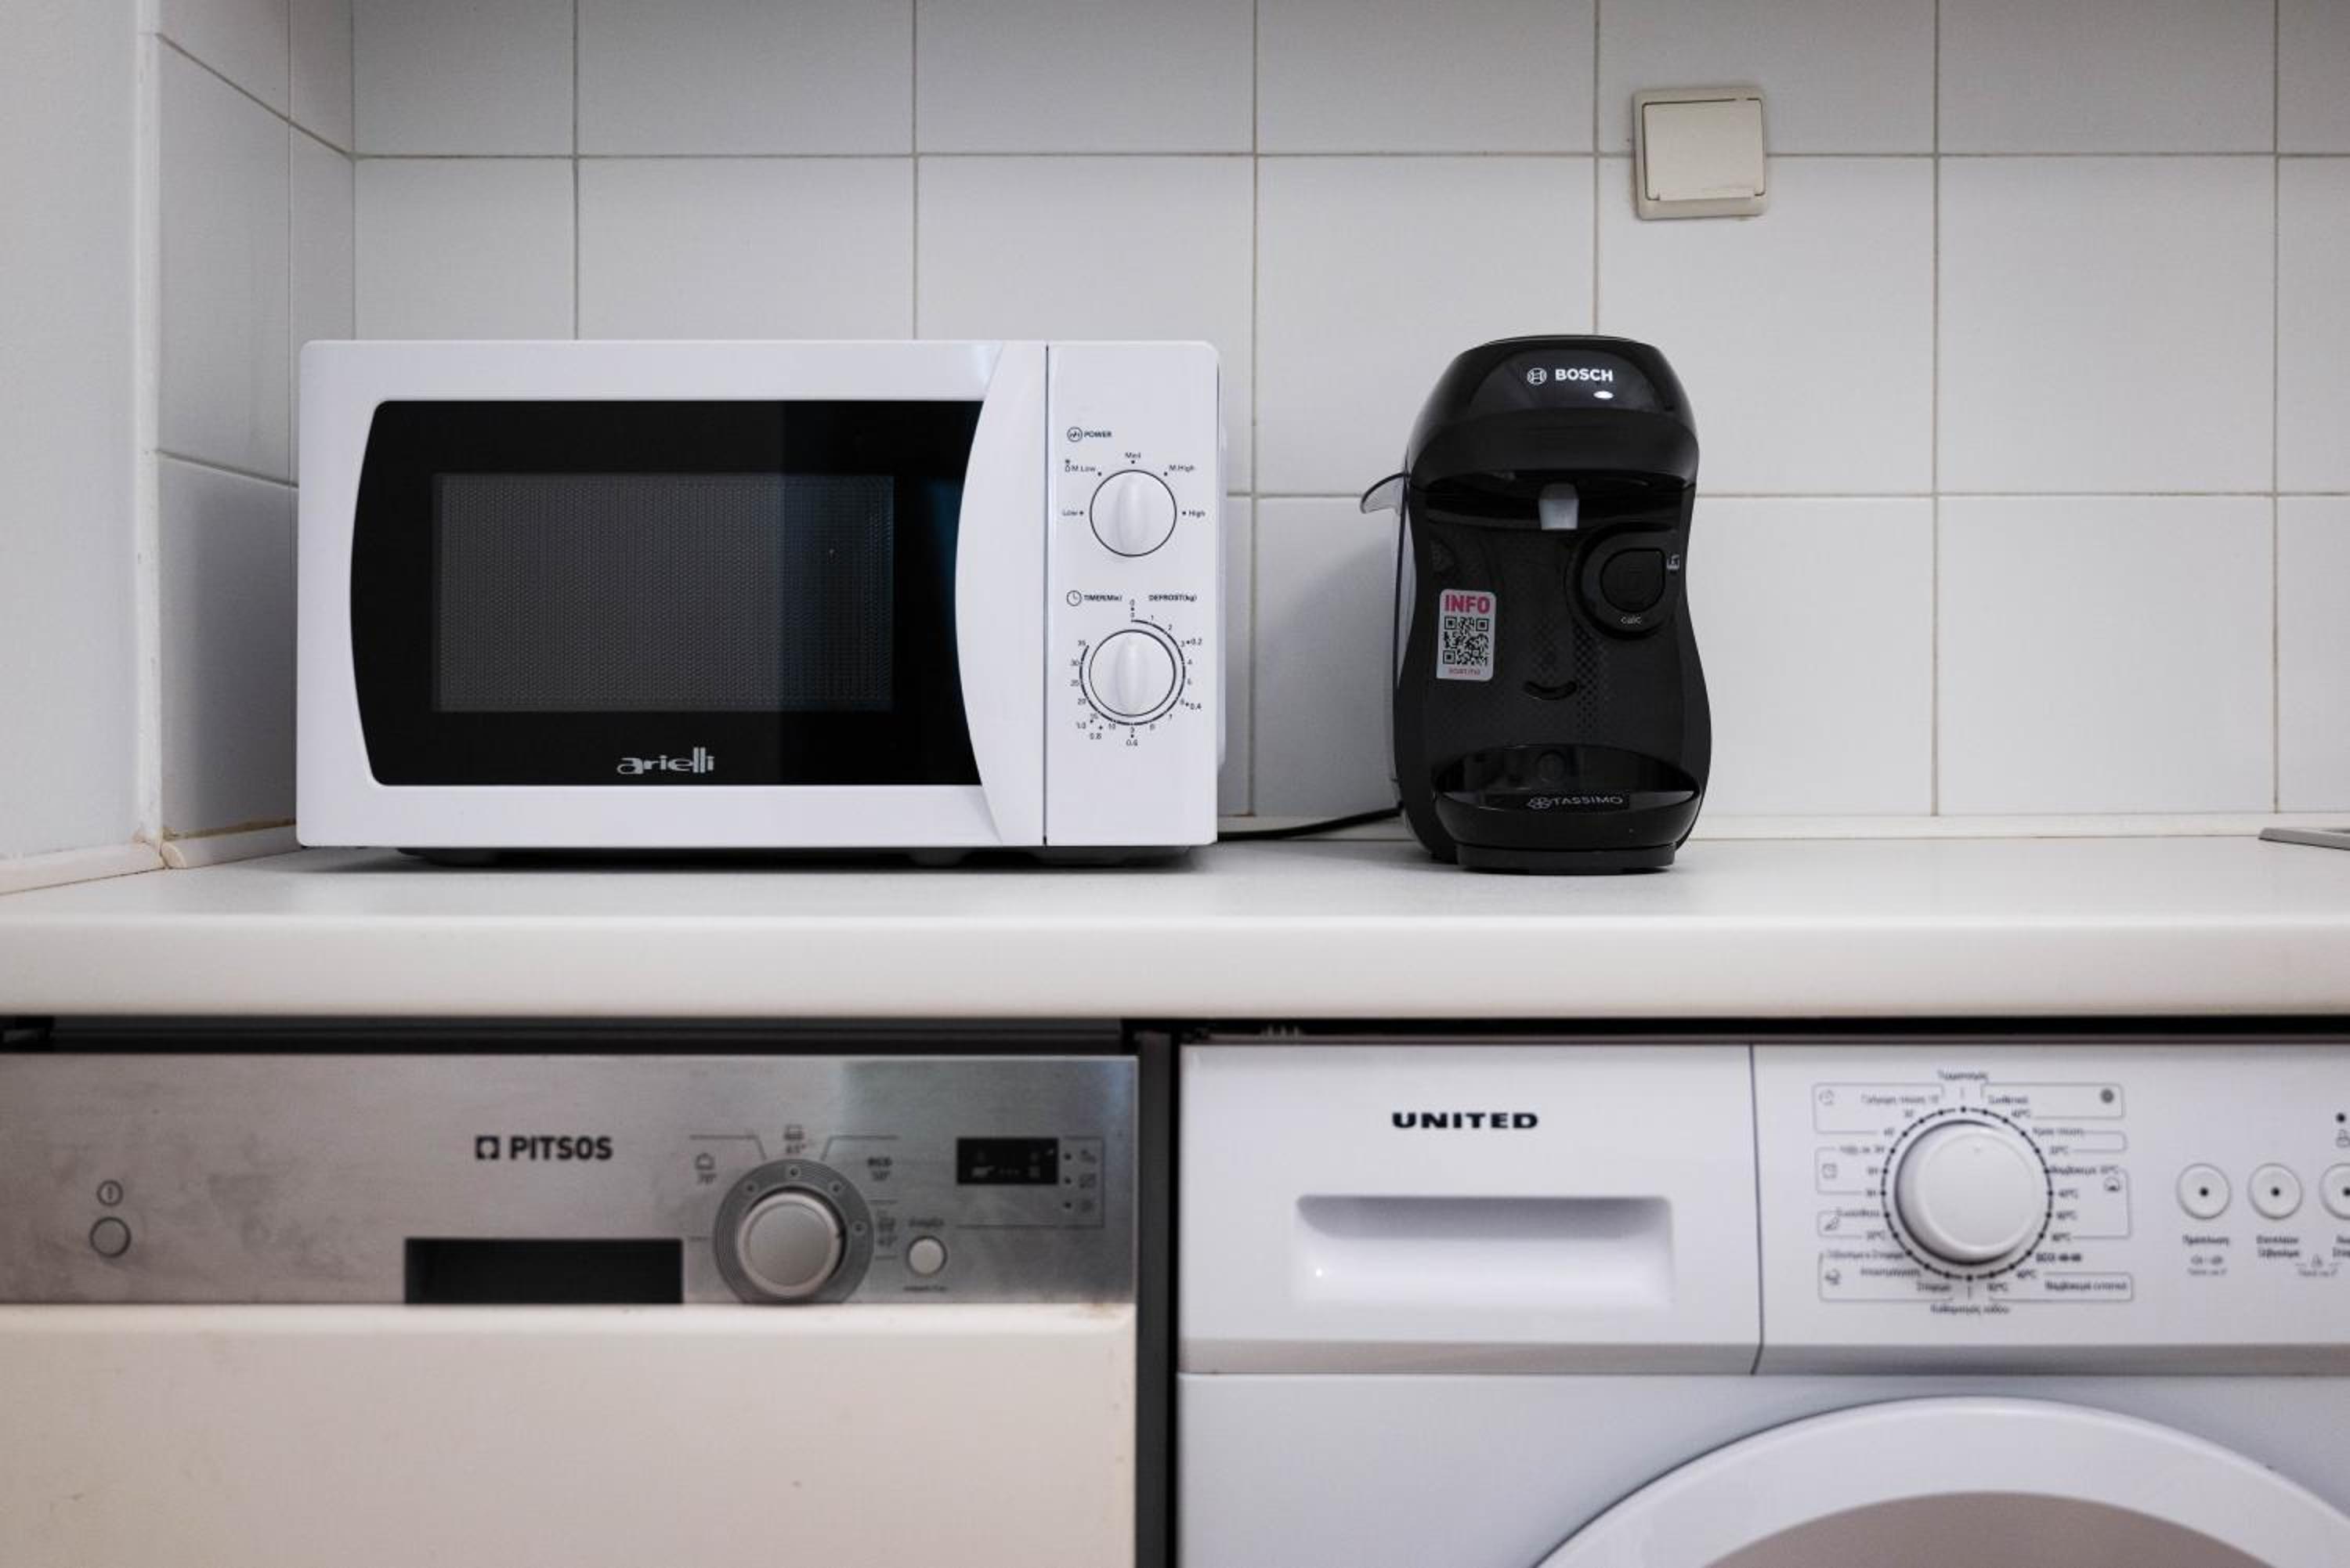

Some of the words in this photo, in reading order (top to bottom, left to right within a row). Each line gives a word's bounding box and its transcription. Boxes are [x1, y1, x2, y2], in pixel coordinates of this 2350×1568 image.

[1555, 367, 1614, 381] BOSCH
[1444, 594, 1491, 614] INFO
[616, 746, 714, 775] arielli
[1552, 796, 1624, 806] TASSIMO
[1392, 1112, 1538, 1129] UNITED
[510, 1136, 613, 1161] PITSOS
